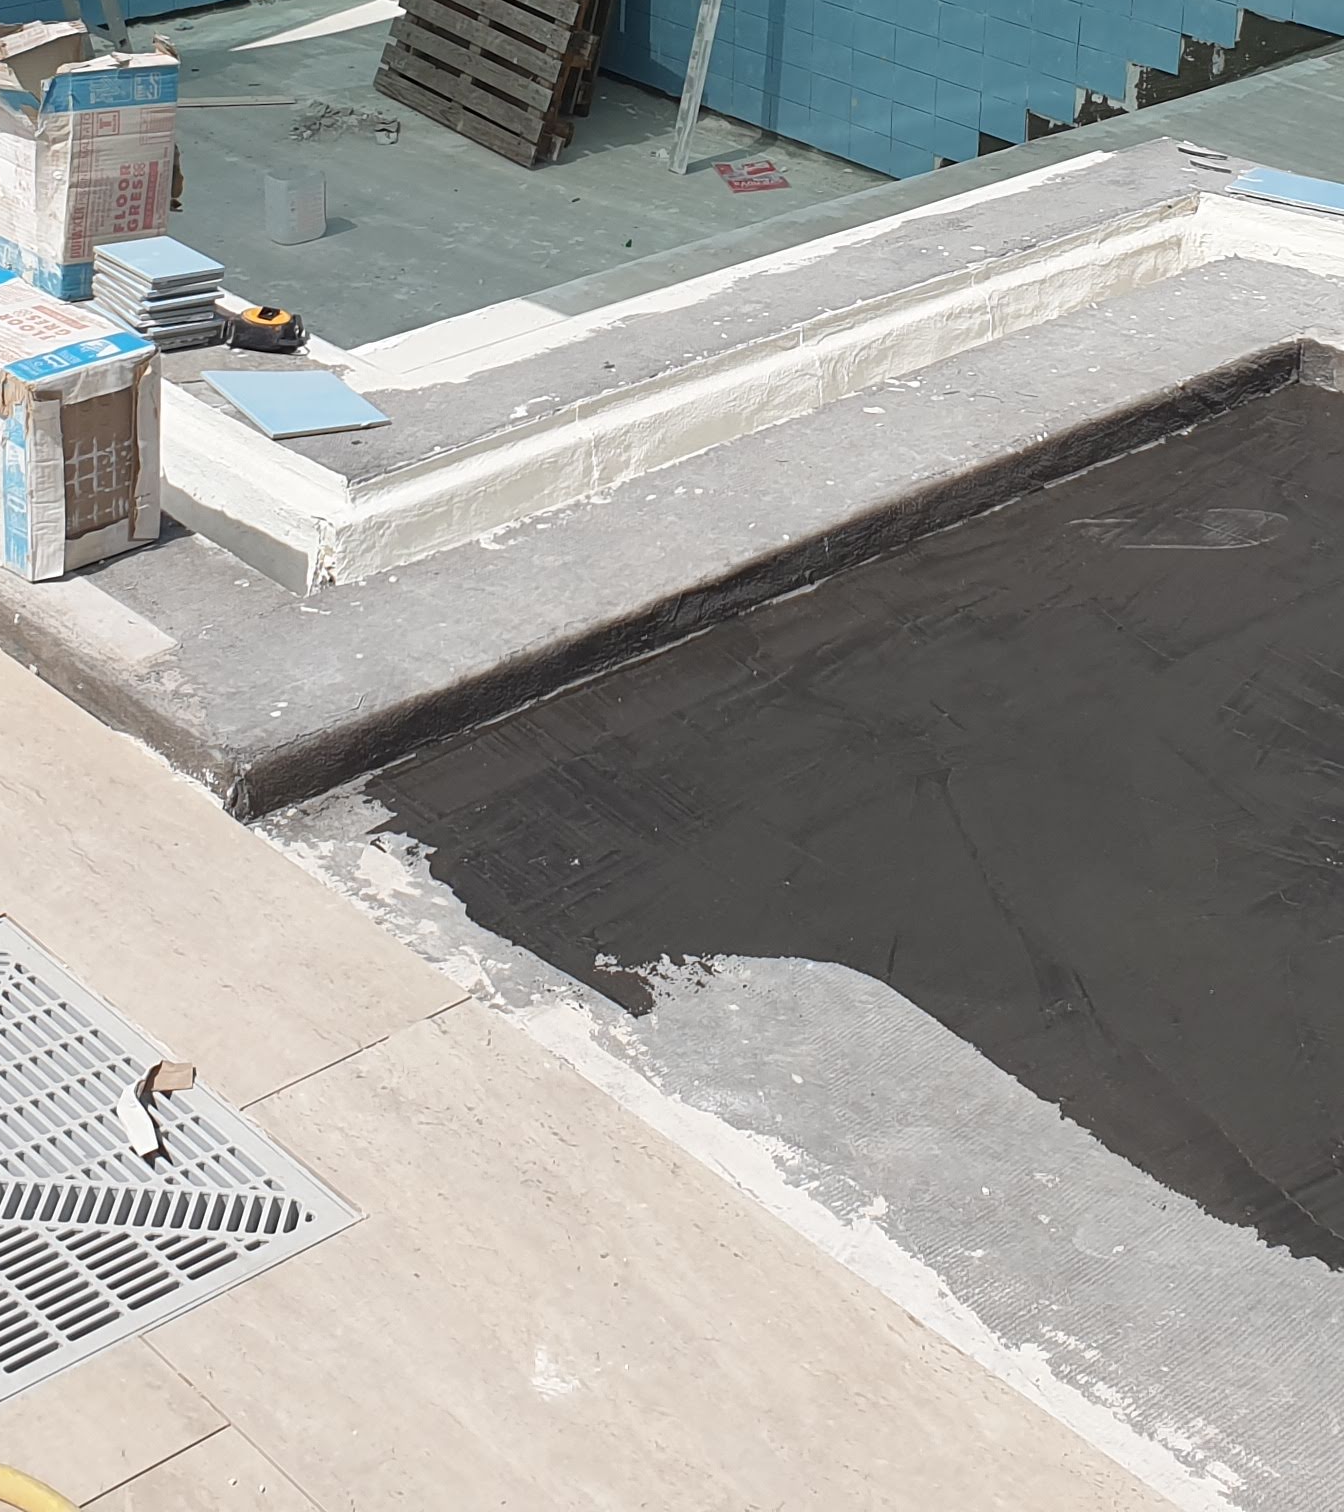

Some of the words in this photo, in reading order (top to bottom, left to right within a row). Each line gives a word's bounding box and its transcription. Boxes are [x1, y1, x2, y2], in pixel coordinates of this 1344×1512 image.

[113, 163, 131, 233] FLOOR
[127, 176, 145, 232] GRES
[25, 314, 71, 336] GRES
